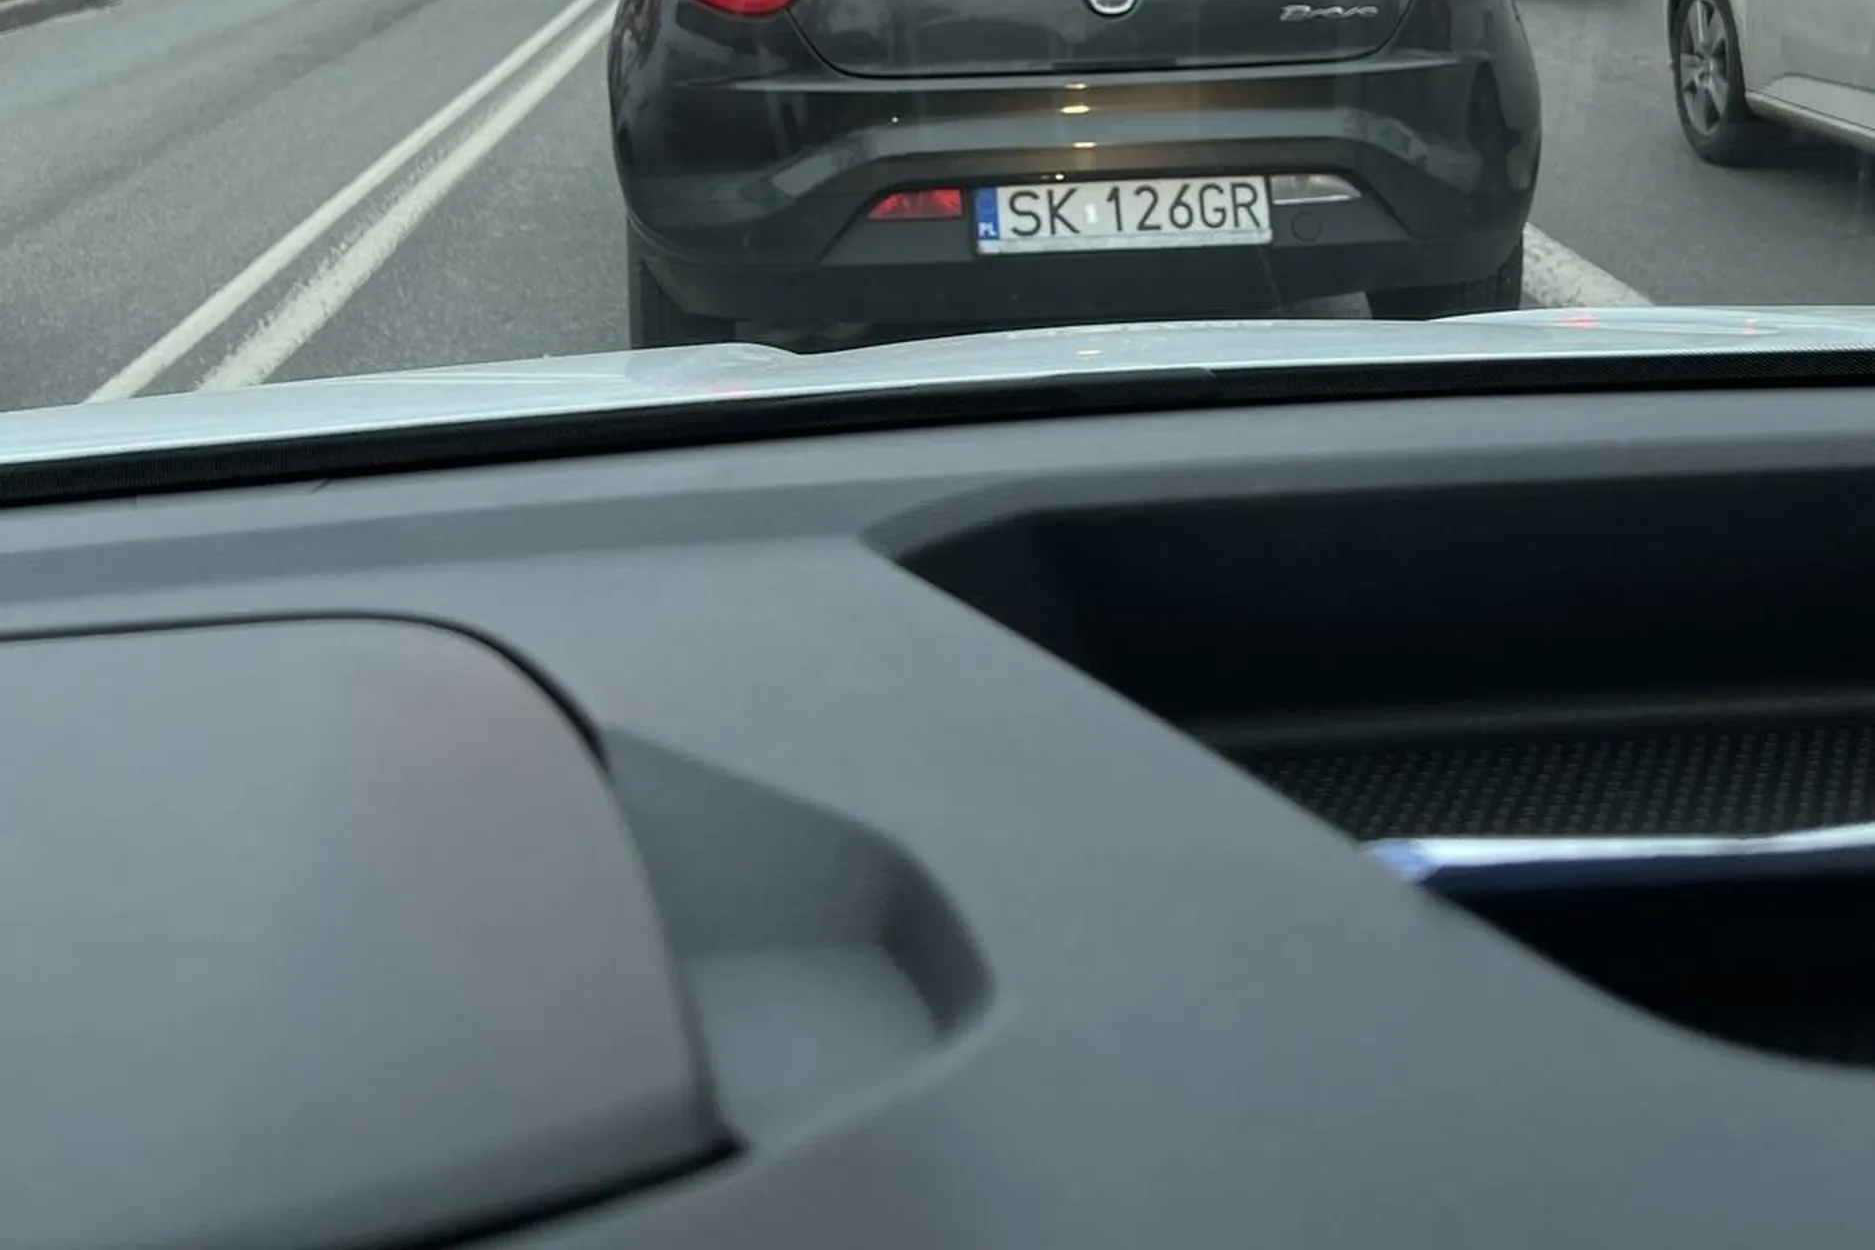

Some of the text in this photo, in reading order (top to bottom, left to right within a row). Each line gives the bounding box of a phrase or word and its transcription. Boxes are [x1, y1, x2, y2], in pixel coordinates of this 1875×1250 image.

[1008, 182, 1261, 237] SK 126GR
[978, 223, 996, 238] PL
